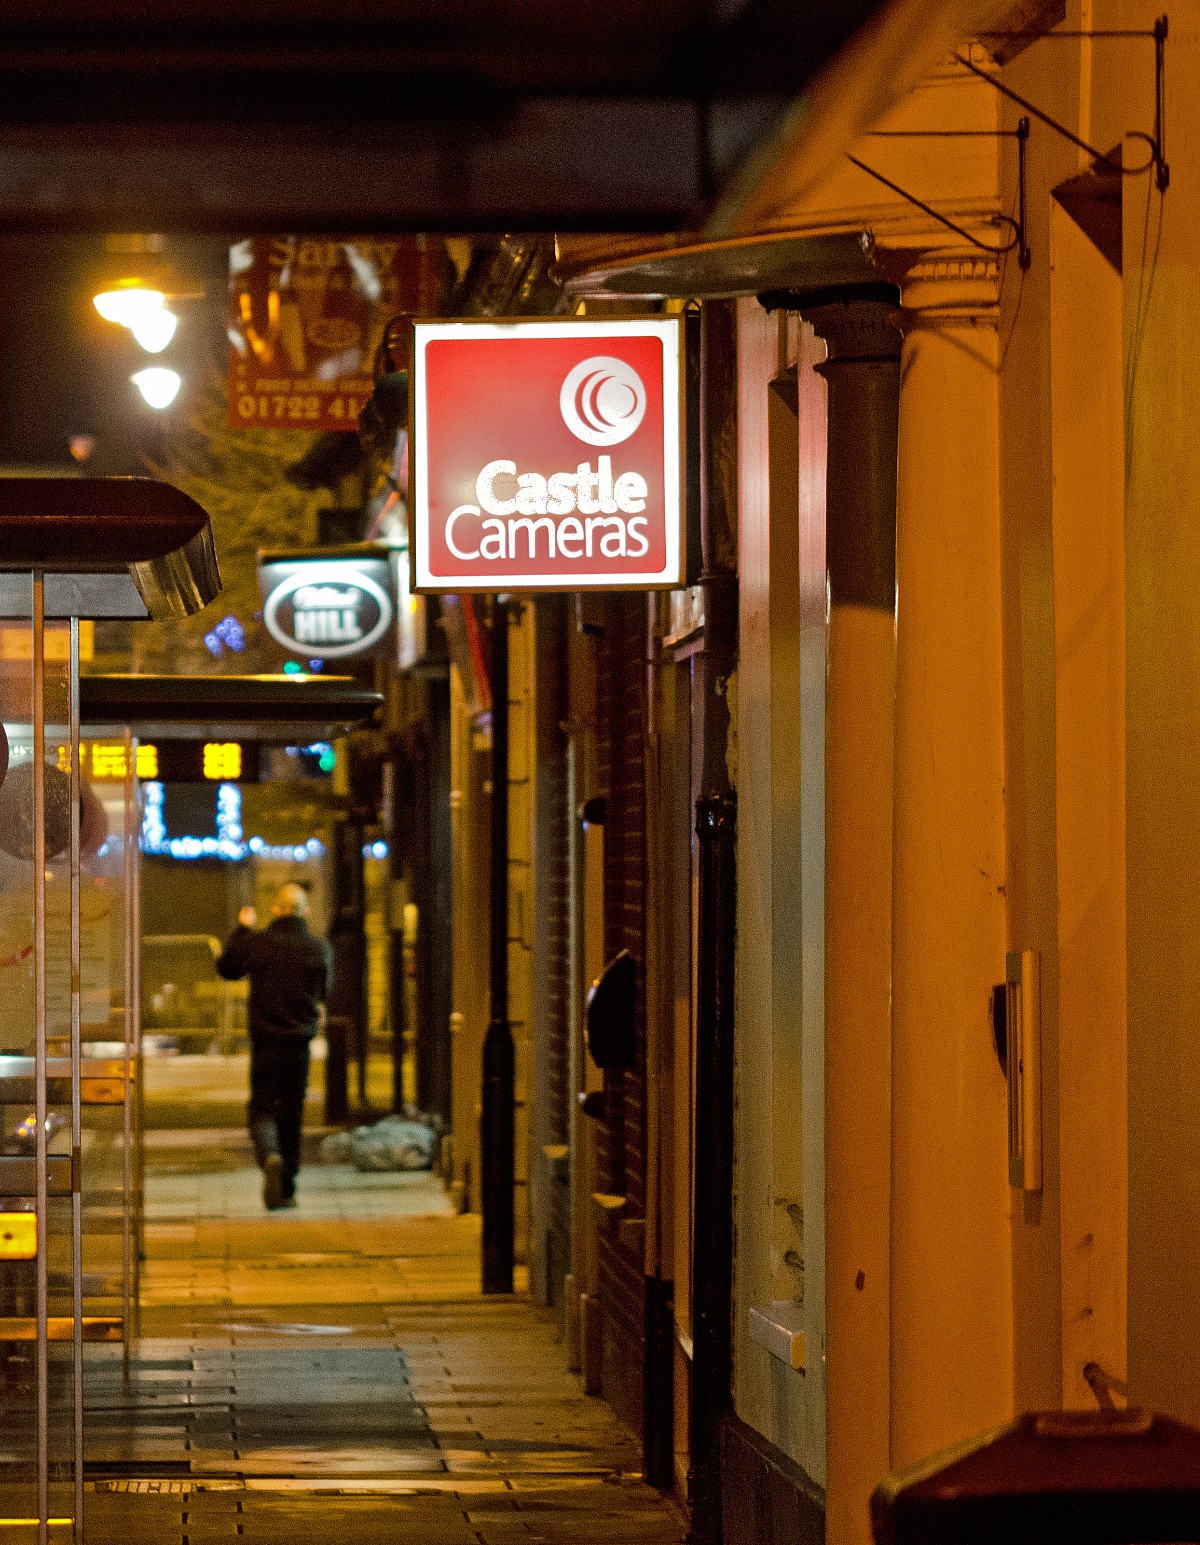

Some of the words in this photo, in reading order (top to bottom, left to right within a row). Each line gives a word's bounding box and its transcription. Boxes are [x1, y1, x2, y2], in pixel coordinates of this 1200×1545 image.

[237, 395, 321, 419] 01722
[328, 395, 366, 419] 41
[475, 455, 648, 515] Castle
[444, 504, 649, 561] Cameras
[294, 609, 363, 642] HILL
